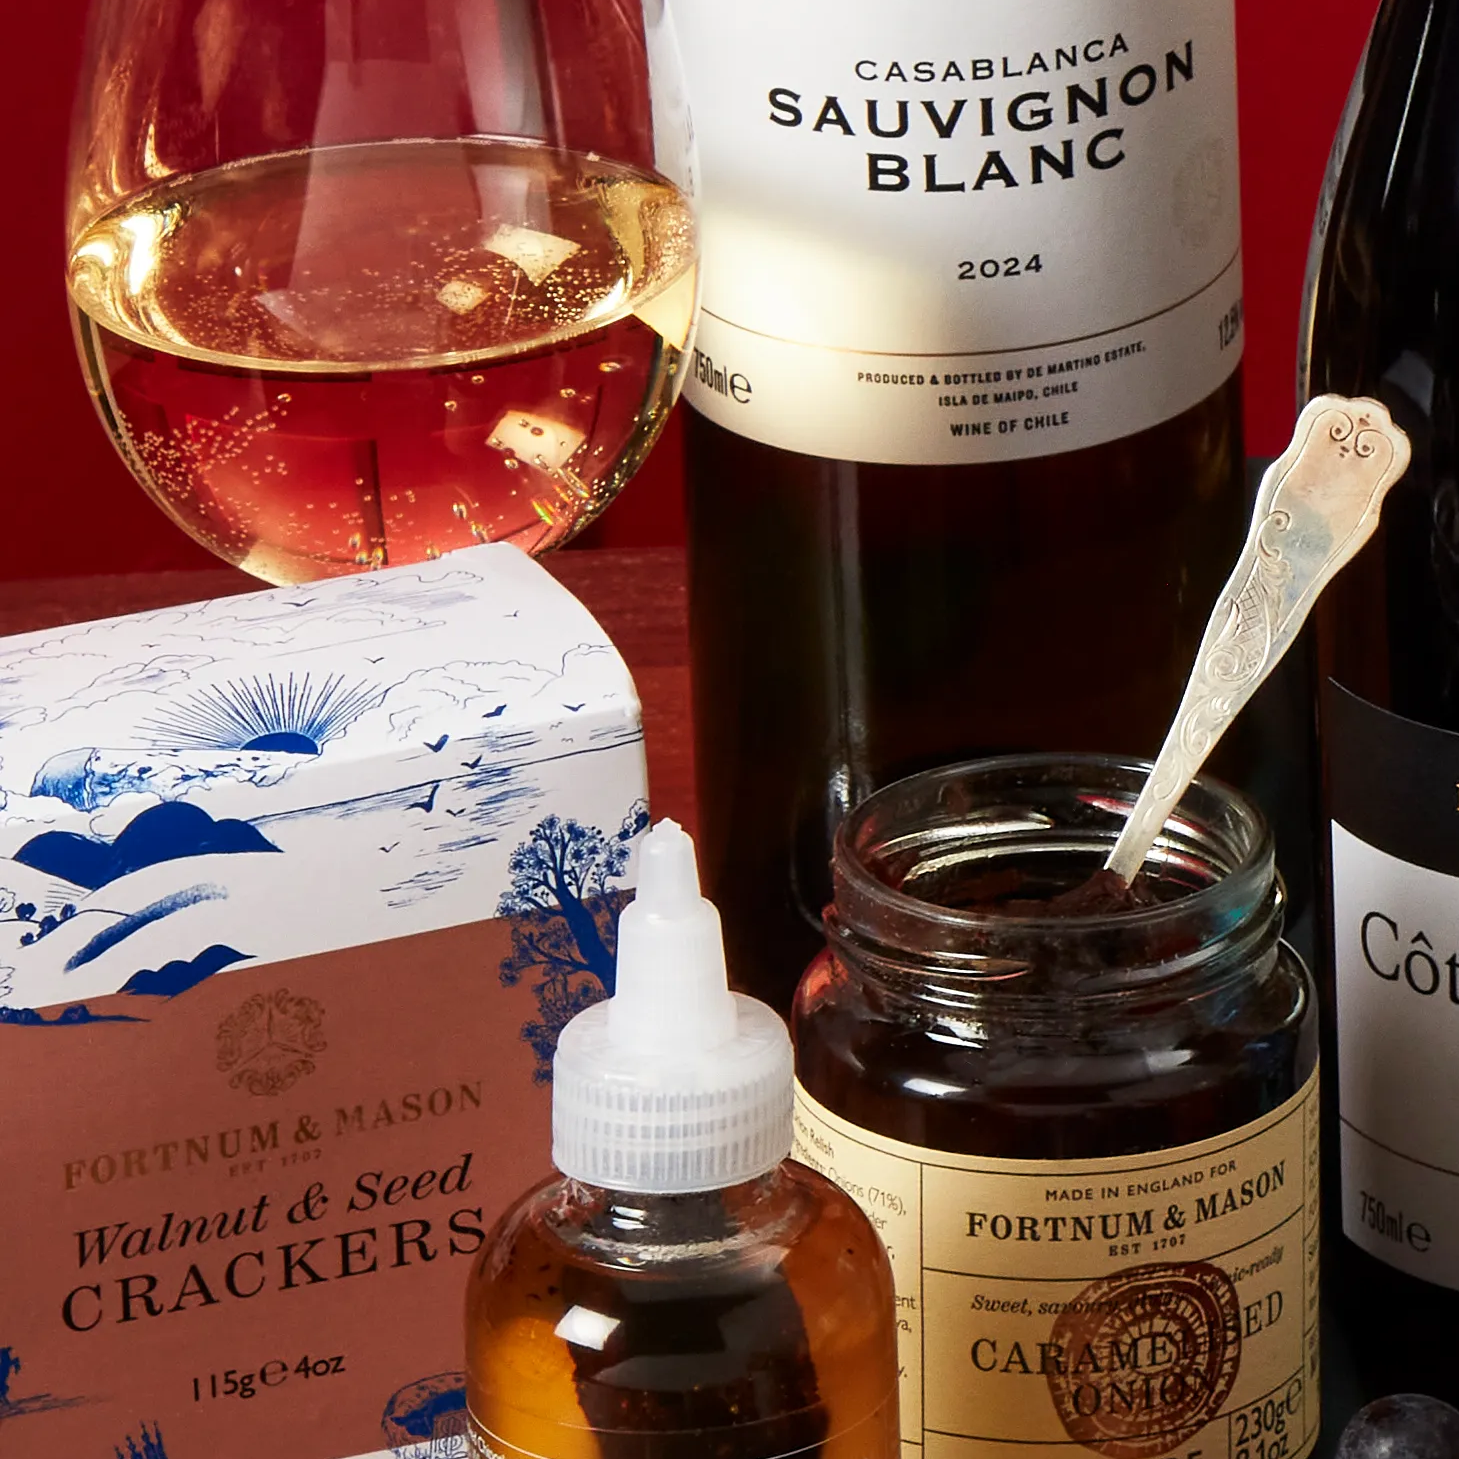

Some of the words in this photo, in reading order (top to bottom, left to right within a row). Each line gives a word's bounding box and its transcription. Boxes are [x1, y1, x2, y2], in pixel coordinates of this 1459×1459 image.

[854, 32, 1130, 83] CASABLANCA
[768, 40, 1198, 140] SAUVIGNON
[866, 127, 1128, 193] BLANC
[957, 253, 1044, 281] 2024
[857, 371, 925, 386] PRODUCED
[944, 370, 1002, 385] BOTTLED
[1006, 368, 1023, 380] BY
[1047, 356, 1101, 376] MARTINO
[938, 395, 969, 408] ISLA
[994, 389, 1039, 404] MAIPO,
[1043, 381, 1079, 398] CHILE
[950, 422, 993, 437] WINE
[998, 419, 1018, 434] OF
[1024, 411, 1070, 432] CHILE
[61, 1130, 282, 1192] FORTNUM
[292, 1113, 323, 1146] &
[333, 1080, 487, 1139] MASON
[965, 1209, 1155, 1243] FORTNUM
[1164, 1204, 1186, 1231] &
[1194, 1161, 1287, 1224] MASON
[1045, 1189, 1094, 1202] MADE
[1127, 1170, 1205, 1196] ENGLAND
[1210, 1160, 1237, 1179] FOR
[72, 1193, 274, 1270] Walnut
[286, 1181, 331, 1222] &
[347, 1152, 475, 1214] Seed
[59, 1205, 489, 1333] CRACKERS
[970, 1294, 1033, 1317] Sweet,
